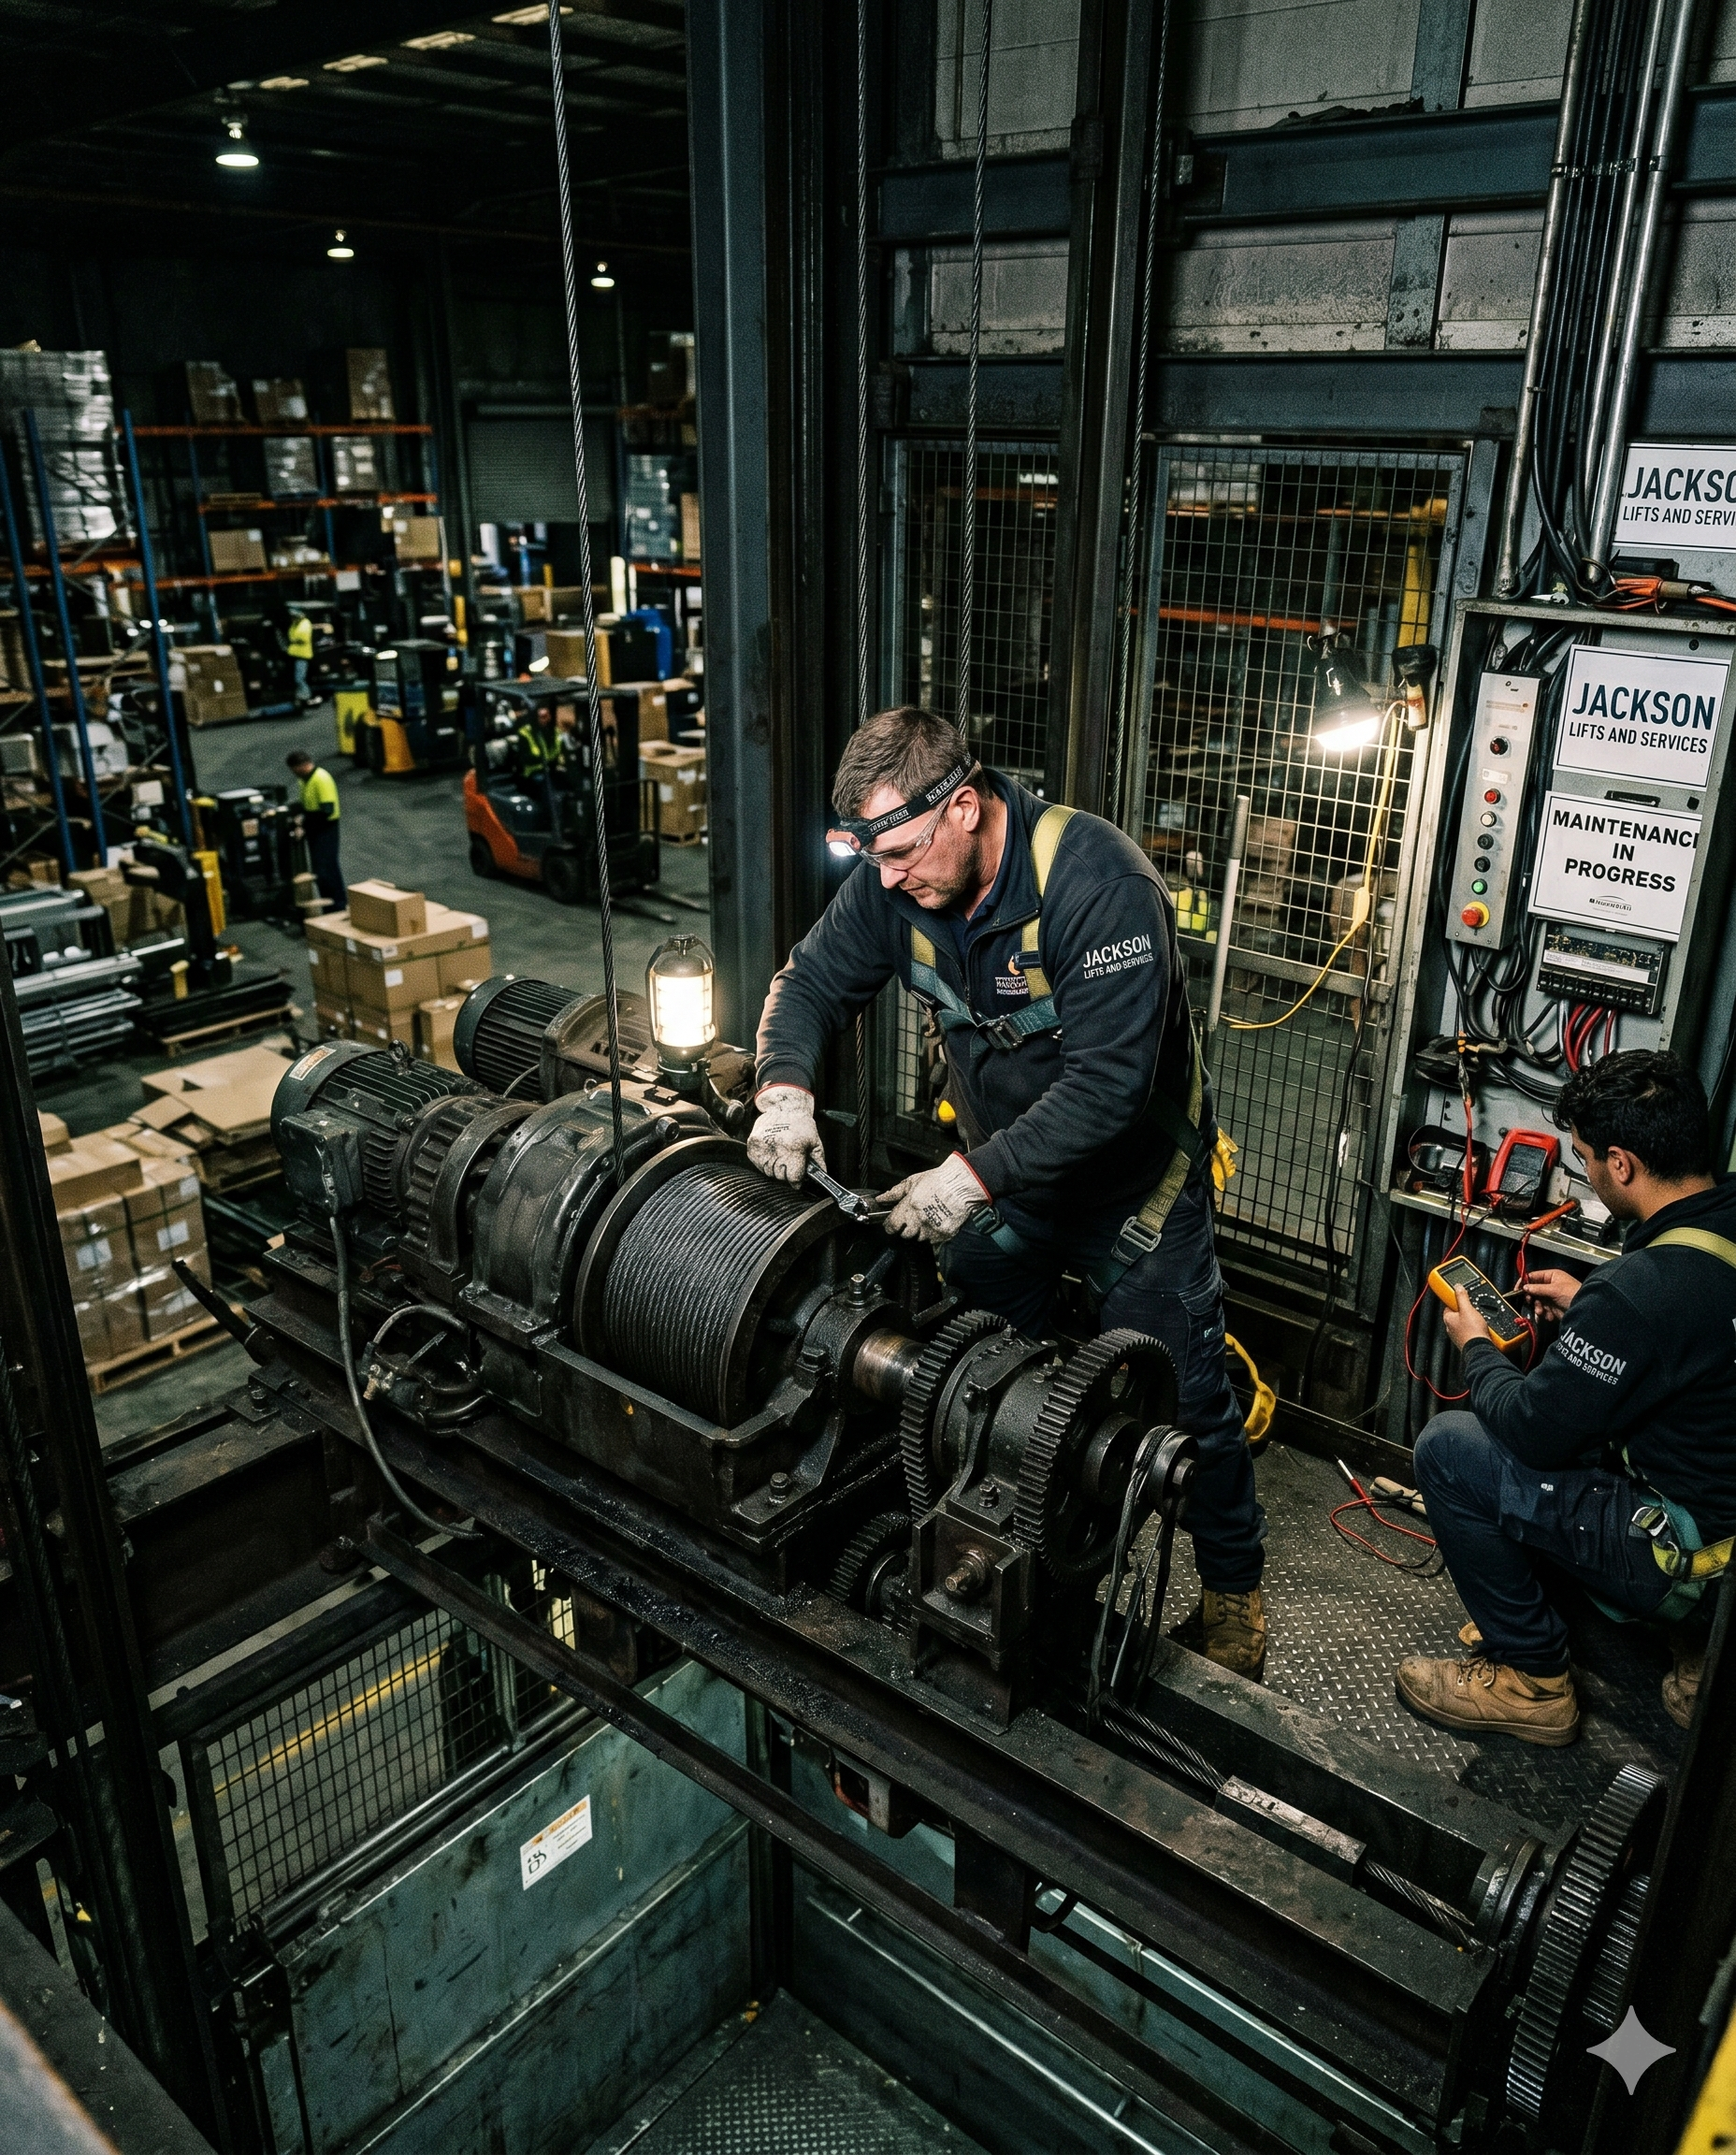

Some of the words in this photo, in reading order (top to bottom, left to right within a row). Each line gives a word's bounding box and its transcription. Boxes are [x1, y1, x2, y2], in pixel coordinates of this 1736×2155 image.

[1623, 506, 1659, 523] LIFTS
[1662, 508, 1691, 524] AND
[1572, 683, 1715, 730] JACKSON
[1569, 722, 1605, 741] LIFTS
[1608, 727, 1637, 745] AND
[1640, 731, 1708, 754] SERVICES
[1613, 843, 1635, 861] IN
[1564, 858, 1676, 892] PROGRESS
[1083, 933, 1151, 968] JACKSON
[1106, 962, 1121, 974] AND
[1560, 1326, 1628, 1376] JACKSON
